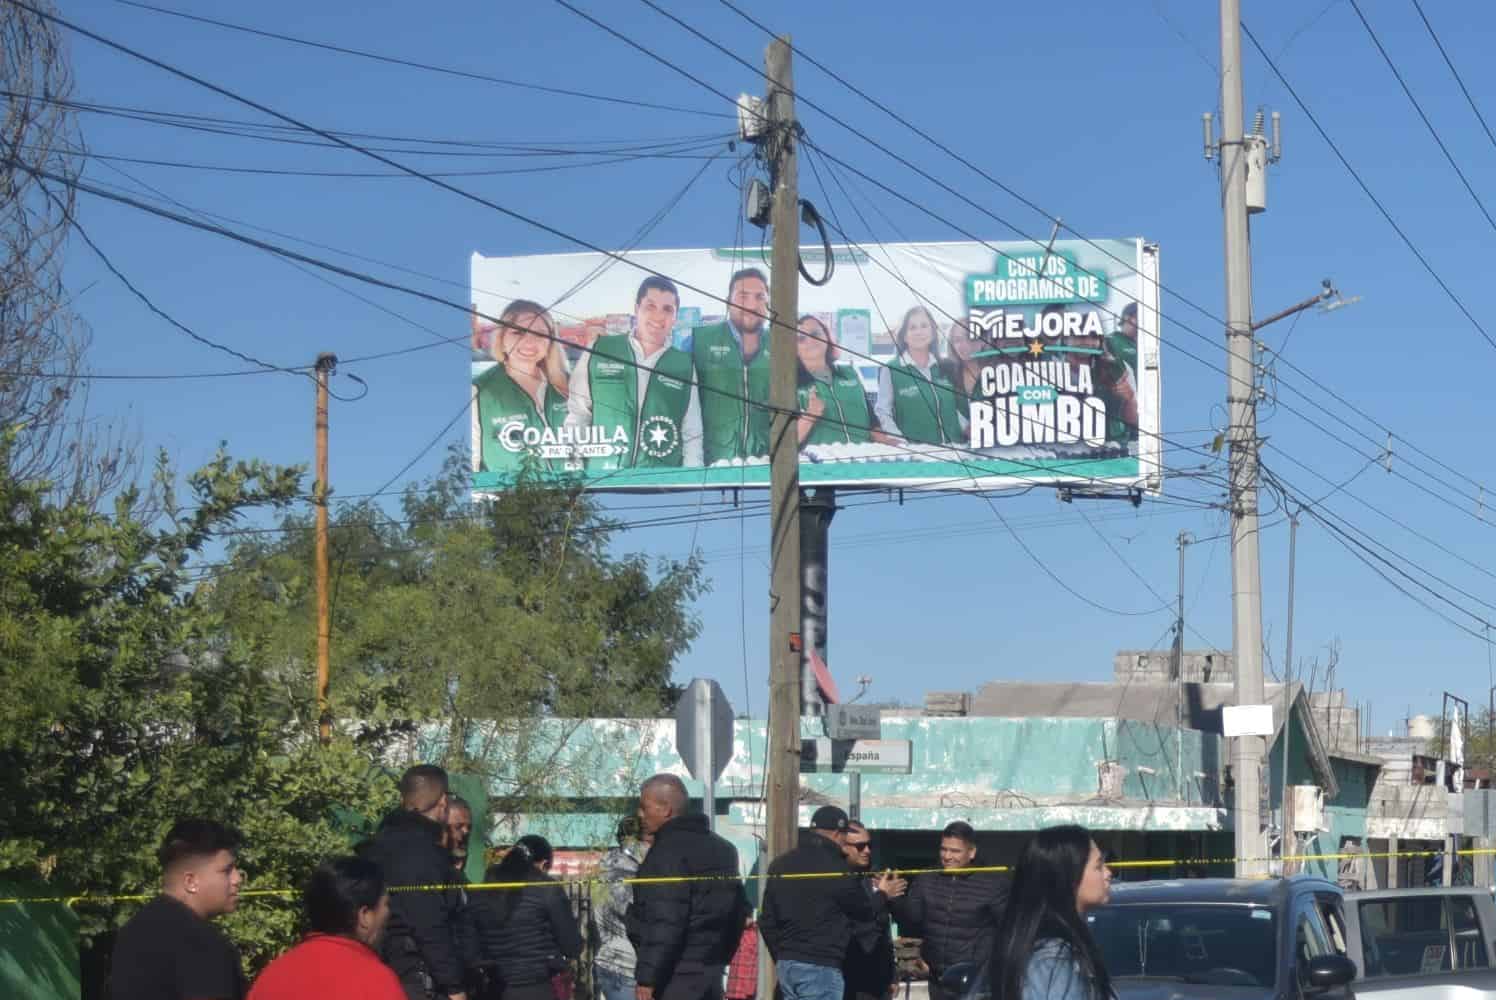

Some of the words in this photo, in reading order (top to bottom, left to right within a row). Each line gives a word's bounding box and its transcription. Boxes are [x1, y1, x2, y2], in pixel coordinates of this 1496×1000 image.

[1007, 257, 1037, 277] CON
[1040, 255, 1066, 280] LOS
[973, 278, 1075, 301] PROGRAMAS
[1078, 277, 1099, 298] DE
[969, 308, 1104, 339] MEJORA
[981, 361, 1094, 397] COAHUILA
[1023, 390, 1052, 400] CON
[498, 420, 629, 453] COAHUILA
[970, 394, 1107, 449] RUMBO
